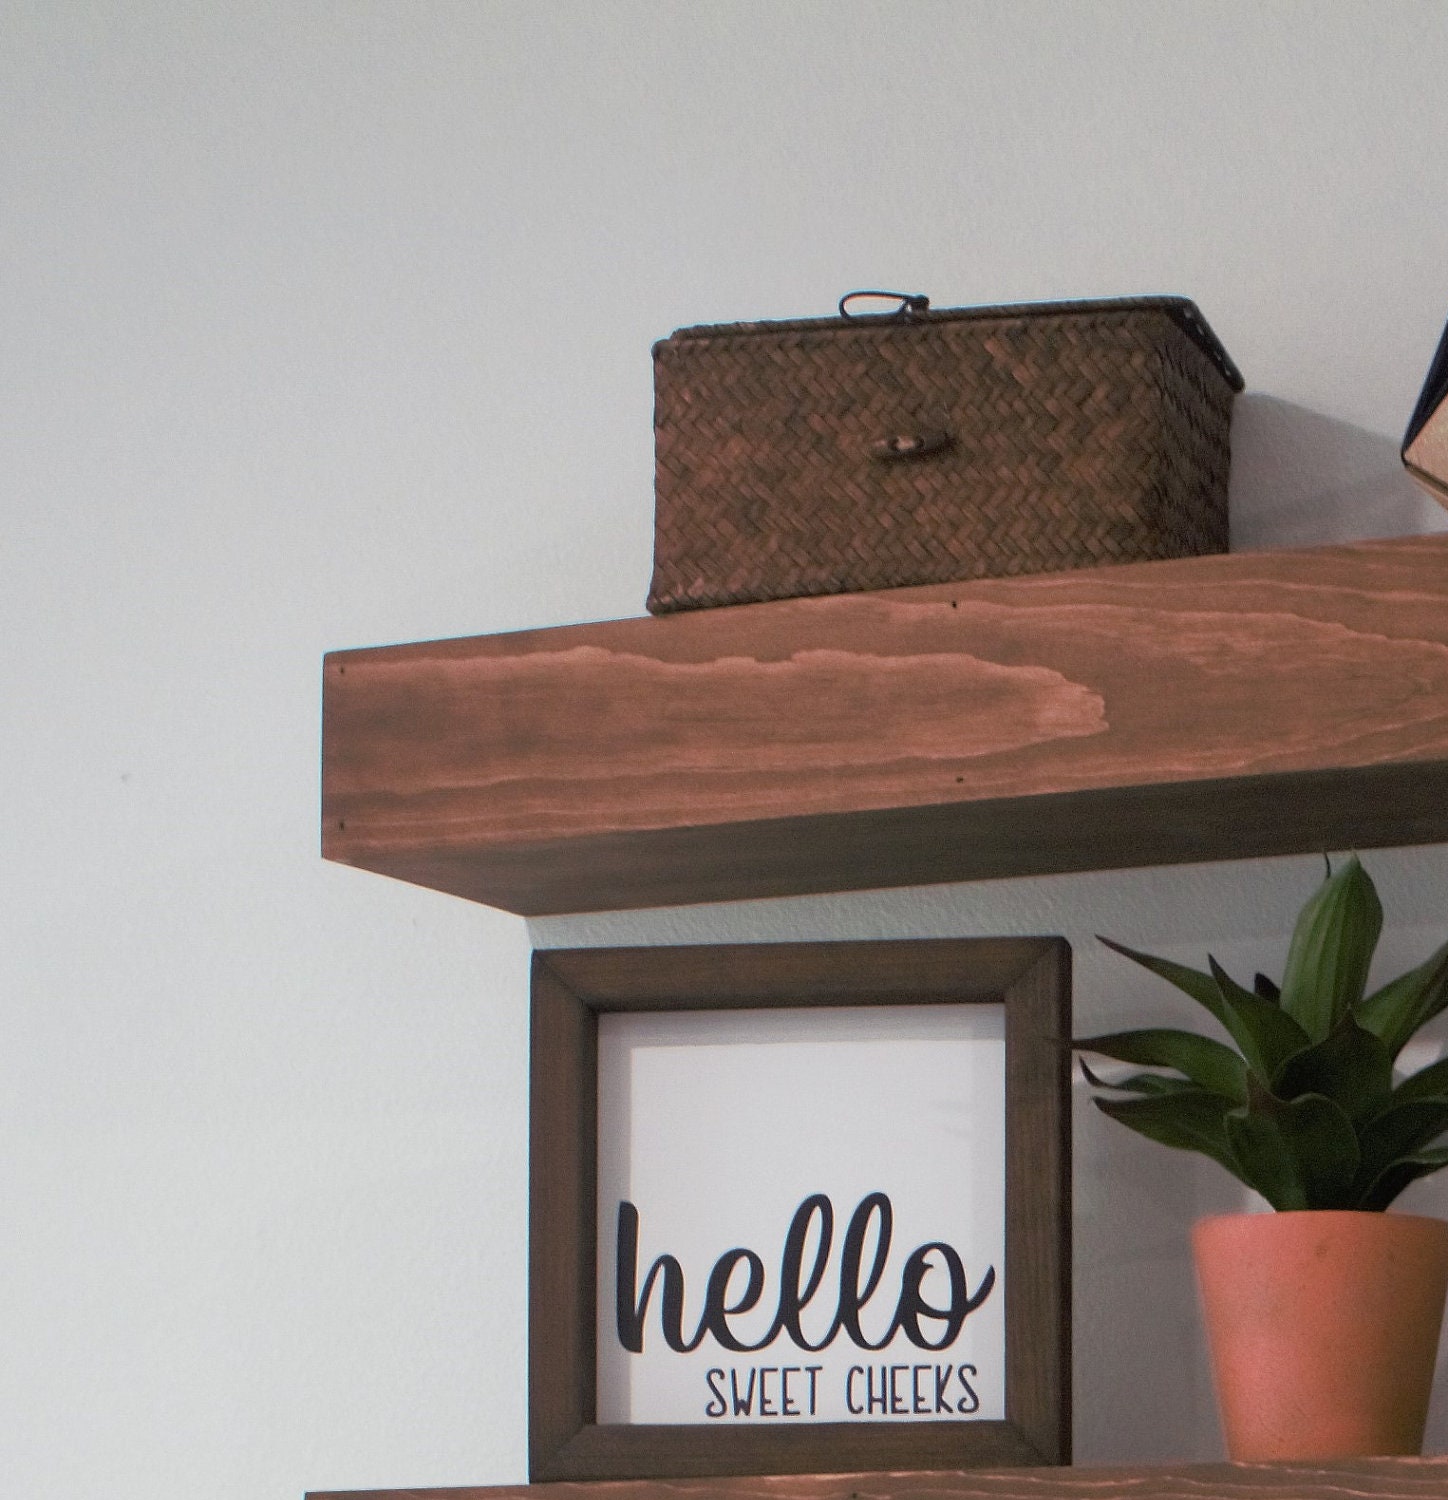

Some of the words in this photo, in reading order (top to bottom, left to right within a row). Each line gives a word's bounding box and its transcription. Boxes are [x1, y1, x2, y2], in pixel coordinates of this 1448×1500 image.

[616, 1192, 996, 1353] hello
[705, 1366, 823, 1418] SWEET
[846, 1364, 980, 1416] CHEEKS
